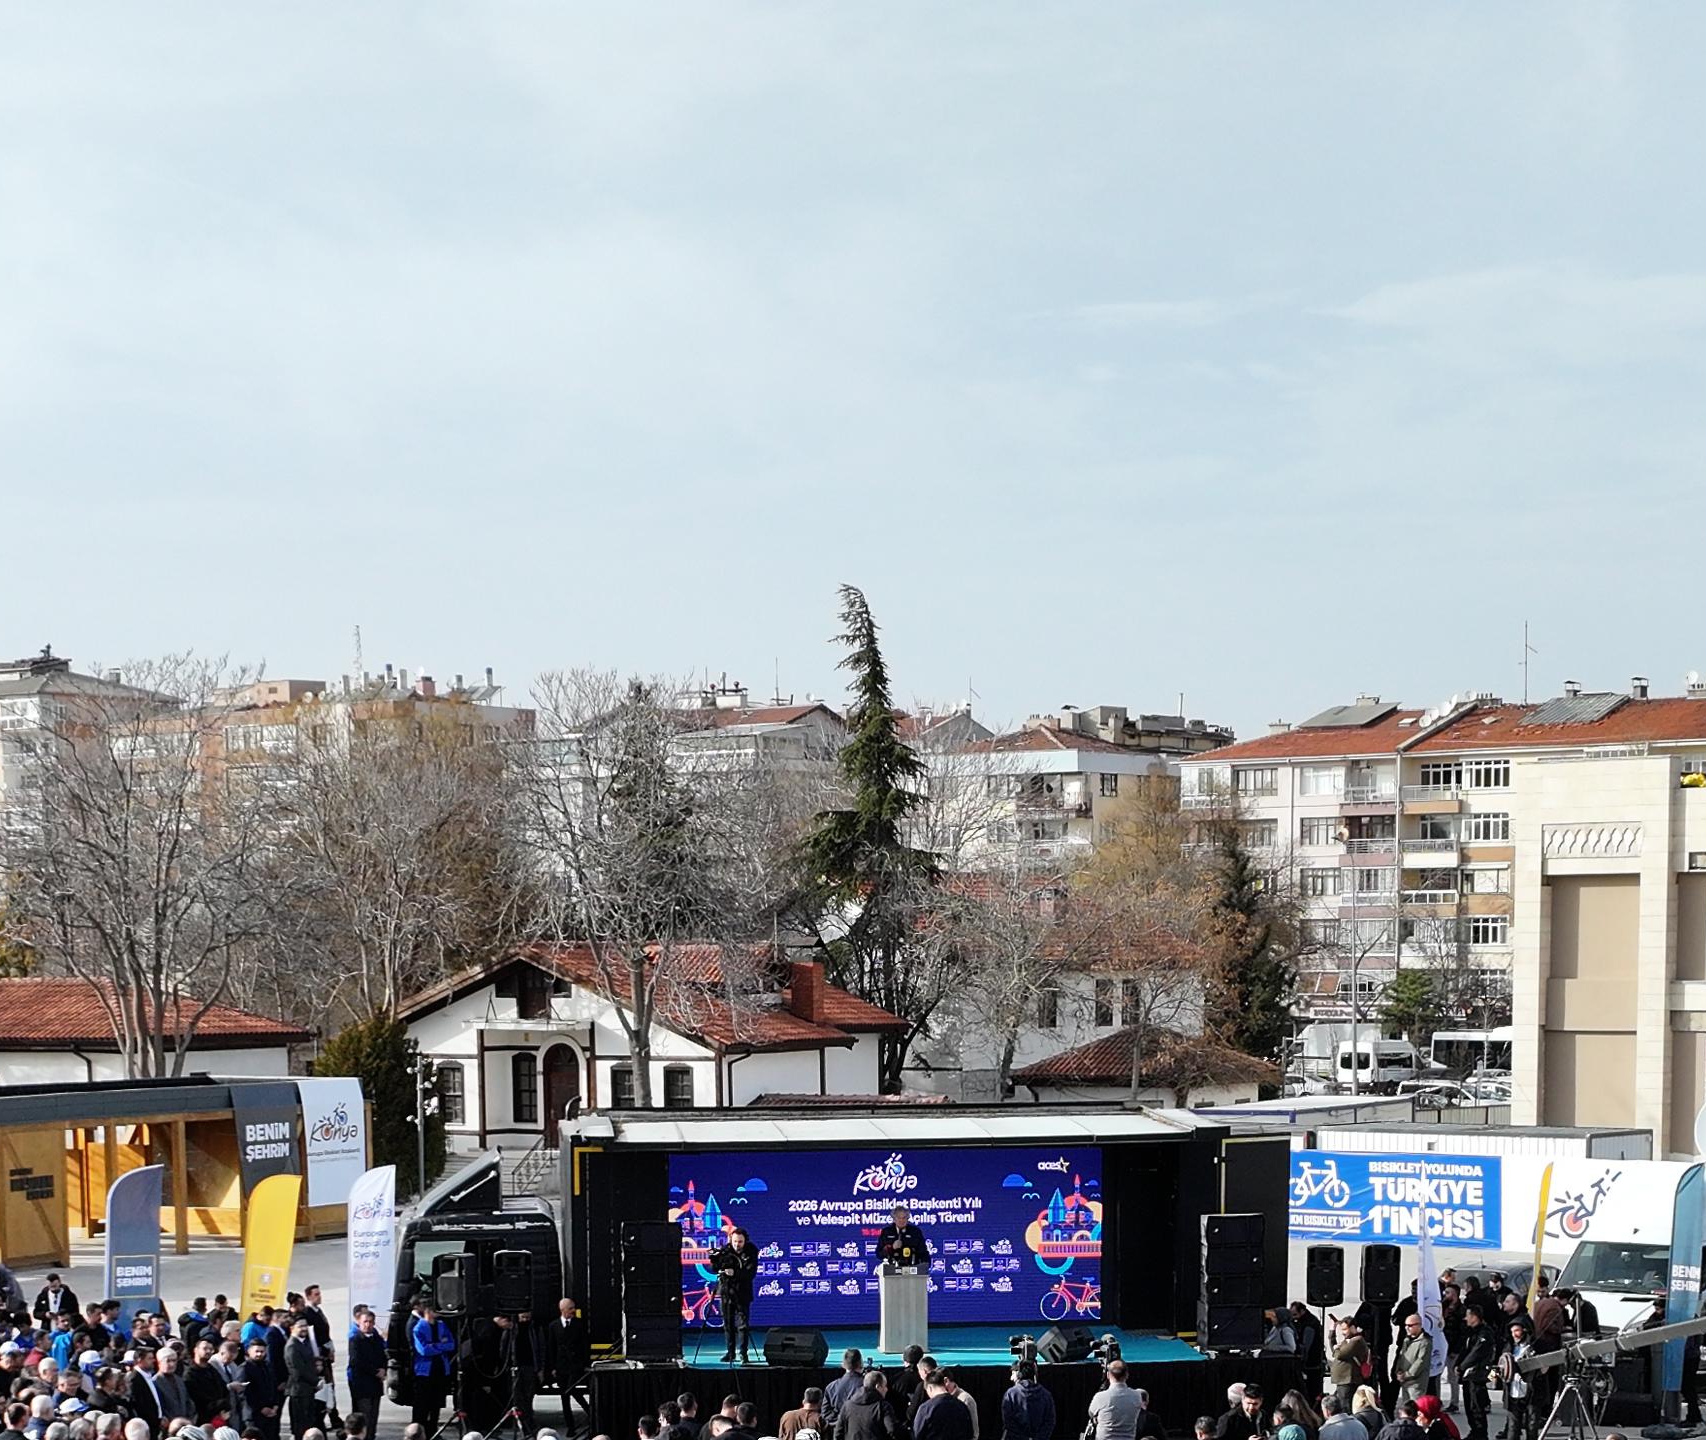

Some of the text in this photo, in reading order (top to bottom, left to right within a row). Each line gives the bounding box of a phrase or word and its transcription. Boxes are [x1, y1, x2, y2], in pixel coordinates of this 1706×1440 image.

[245, 1122, 290, 1142] BENİM
[309, 1120, 358, 1147] Konya
[245, 1142, 290, 1163] ŞEHRİM
[1424, 1163, 1483, 1176] YOLUNDA
[853, 1167, 918, 1195] Konya
[1369, 1176, 1483, 1205] TÜRKİYE
[789, 1201, 818, 1212] 2026
[820, 1200, 862, 1213] Avrupa
[910, 1198, 961, 1212] Başkenti
[964, 1197, 982, 1209] Yılı
[796, 1215, 811, 1225] ve
[813, 1213, 860, 1227] Velespit
[862, 1212, 894, 1224] Müze
[938, 1210, 975, 1223] Töreni
[1340, 1216, 1361, 1227] YOLU
[353, 1230, 388, 1238] Europan
[116, 1266, 152, 1276] BENİM
[116, 1277, 152, 1288] ŞEHRİM
